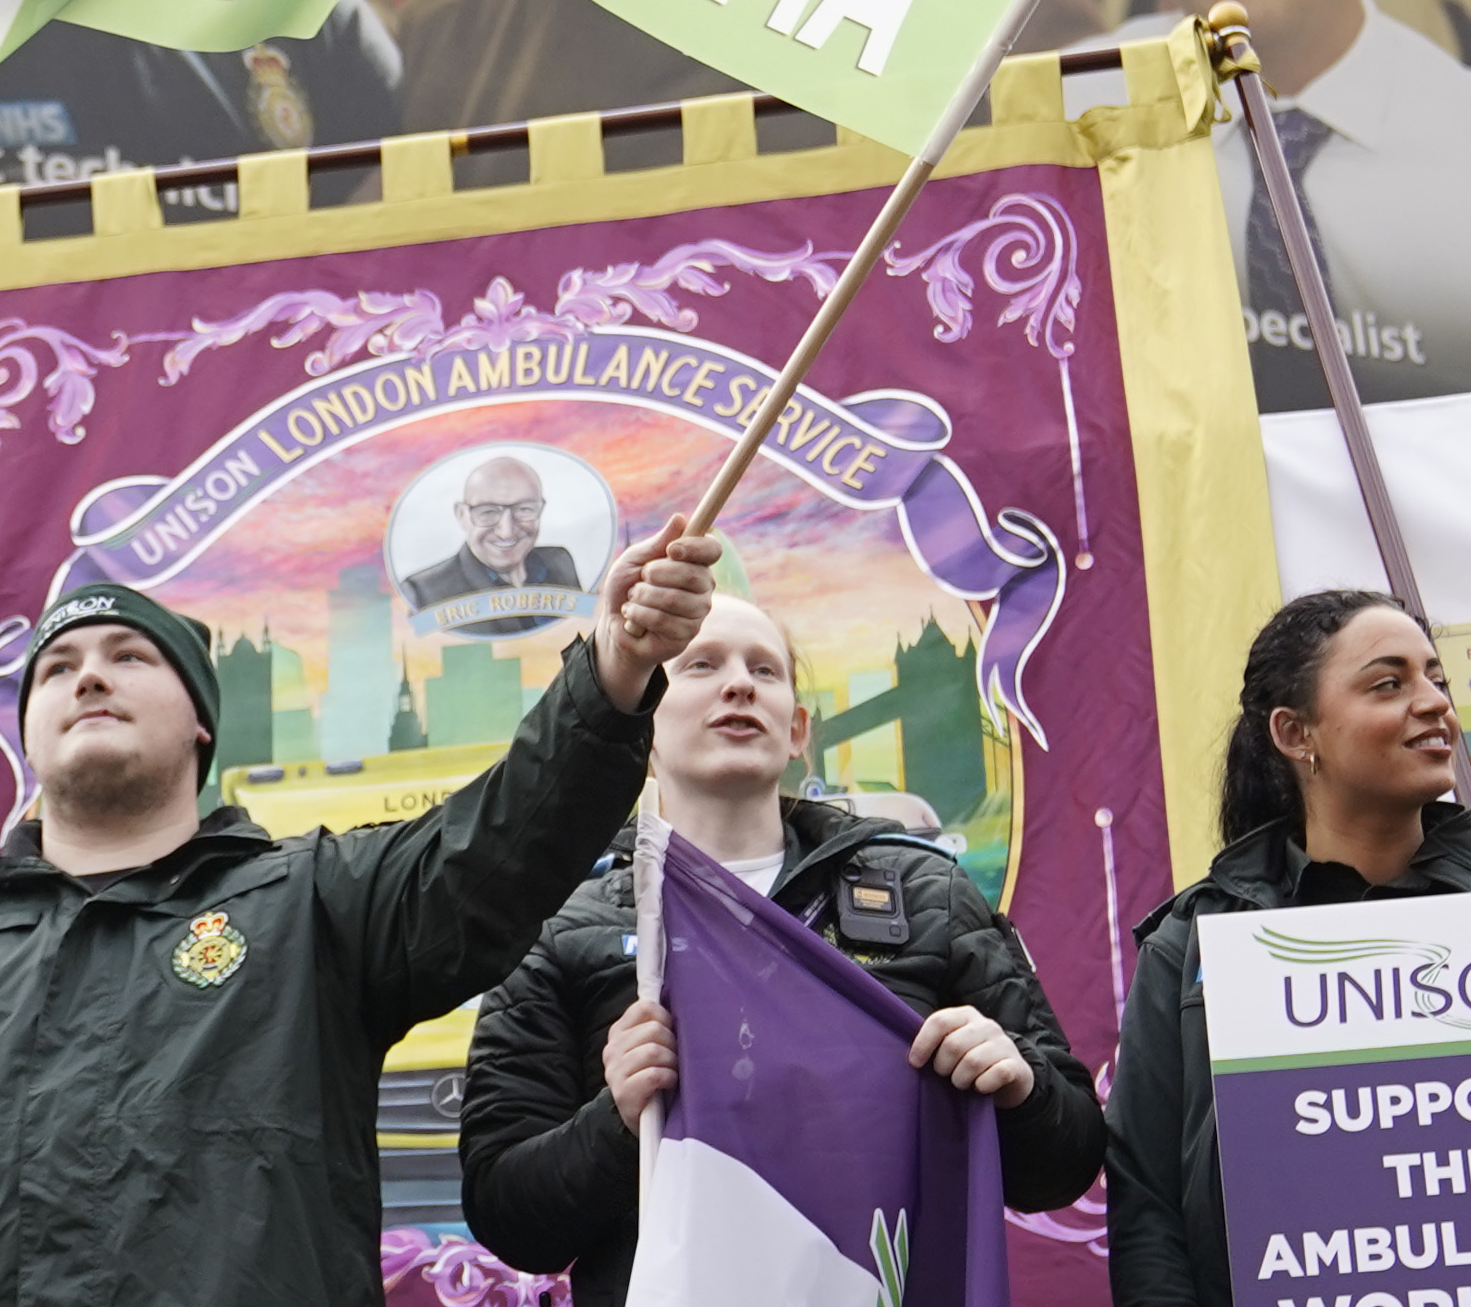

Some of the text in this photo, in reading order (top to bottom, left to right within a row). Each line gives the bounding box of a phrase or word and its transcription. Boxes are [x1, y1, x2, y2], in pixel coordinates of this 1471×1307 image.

[130, 450, 261, 566] UNISON
[258, 360, 438, 464] LONDON
[447, 341, 727, 408] AMBULANCE
[488, 592, 578, 613] ROBERTS
